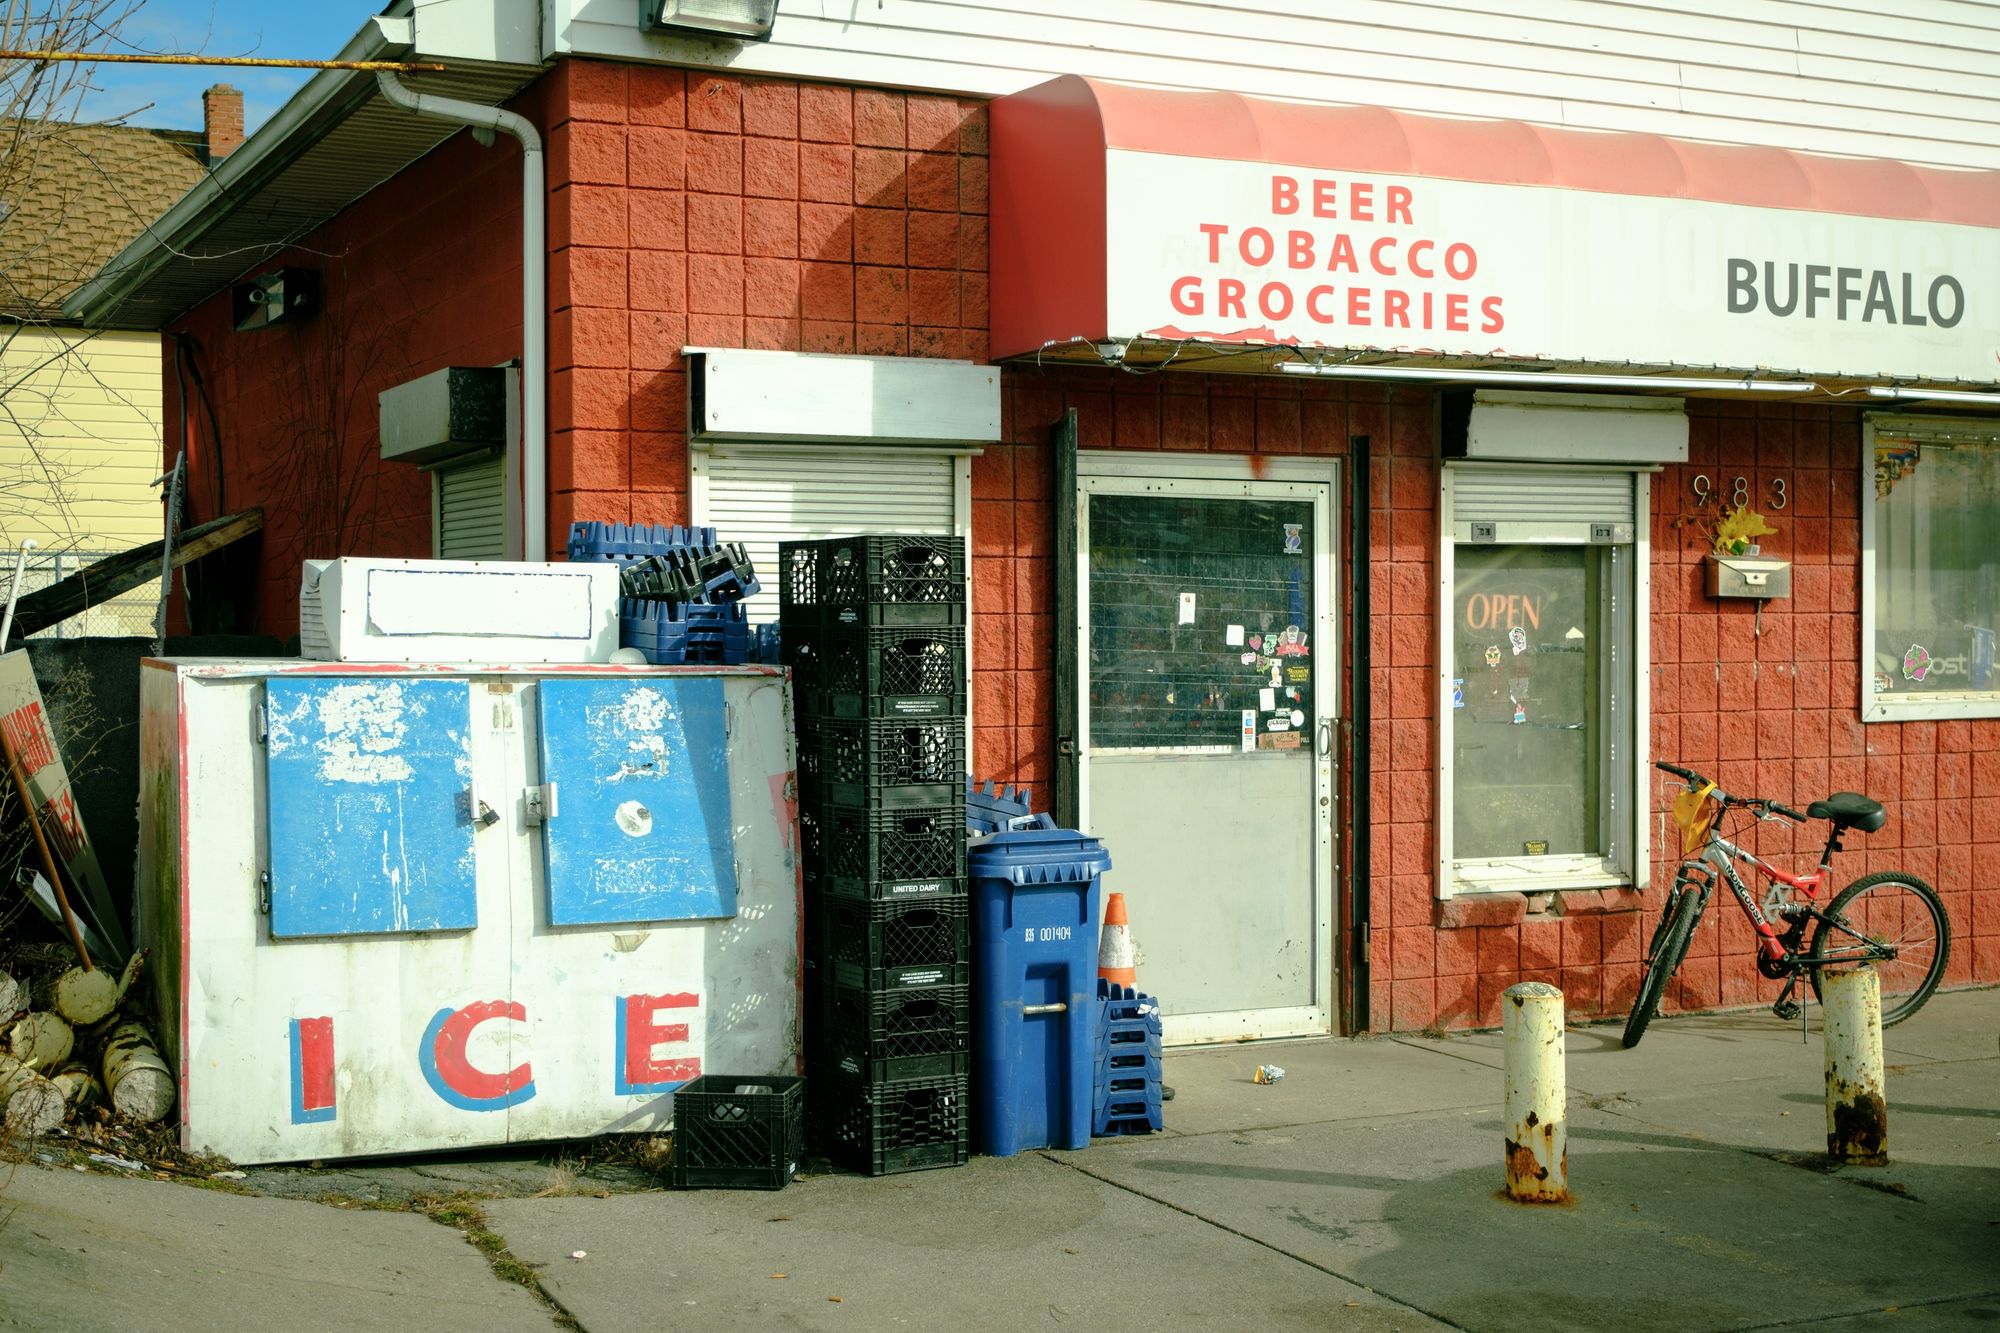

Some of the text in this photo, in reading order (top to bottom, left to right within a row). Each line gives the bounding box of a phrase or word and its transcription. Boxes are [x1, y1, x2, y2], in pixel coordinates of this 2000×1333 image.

[1271, 176, 1414, 225] BEER
[1200, 223, 1478, 281] TOBACCO
[1169, 276, 1505, 334] GROCERIES
[1727, 258, 1965, 329] BUFFALO
[1693, 474, 1787, 509] 983
[1467, 592, 1541, 630] OPEN
[892, 884, 940, 893] UNITED DAIRY
[1725, 864, 1763, 924] MONGOOSE
[1040, 926, 1071, 941] 001404
[290, 993, 702, 1125] ICE
